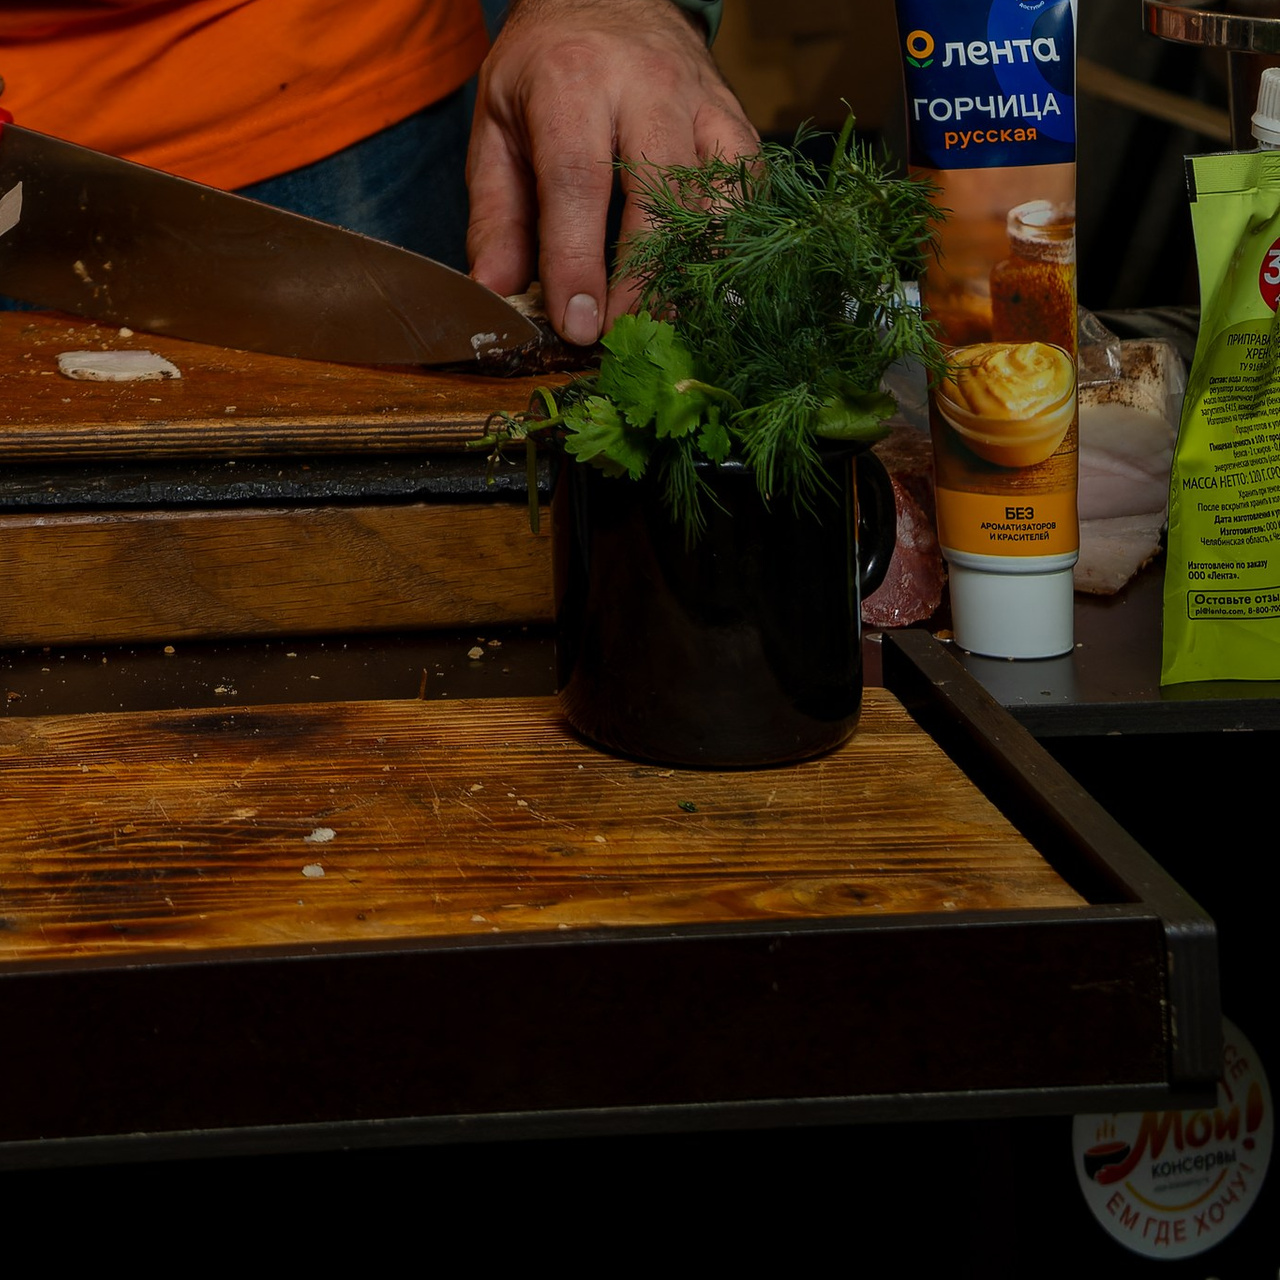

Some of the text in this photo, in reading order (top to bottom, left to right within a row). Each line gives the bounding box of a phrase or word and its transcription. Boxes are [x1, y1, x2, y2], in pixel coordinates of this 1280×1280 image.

[942, 36, 1060, 68] лента
[913, 92, 1061, 122] ГОРЧИЦА
[944, 126, 1037, 150] русская
[1183, 476, 1217, 490] МАССА
[1220, 472, 1249, 488] НЕТТО:
[1005, 506, 1034, 520] БЕЗ
[1198, 502, 1219, 512] После
[1214, 515, 1232, 524] Дата
[981, 522, 1056, 532] АРОМАТИЗАТОРОВ
[997, 530, 1050, 541] КРАСИТЕЛЕЙ
[1188, 561, 1234, 570] Изготовлено
[1247, 560, 1268, 569] заказу
[1194, 593, 1252, 605] Оставьте
[1151, 1148, 1236, 1179] консервы
[1106, 1162, 1254, 1246] ЕМ ГДЕ ХОЧУ!
